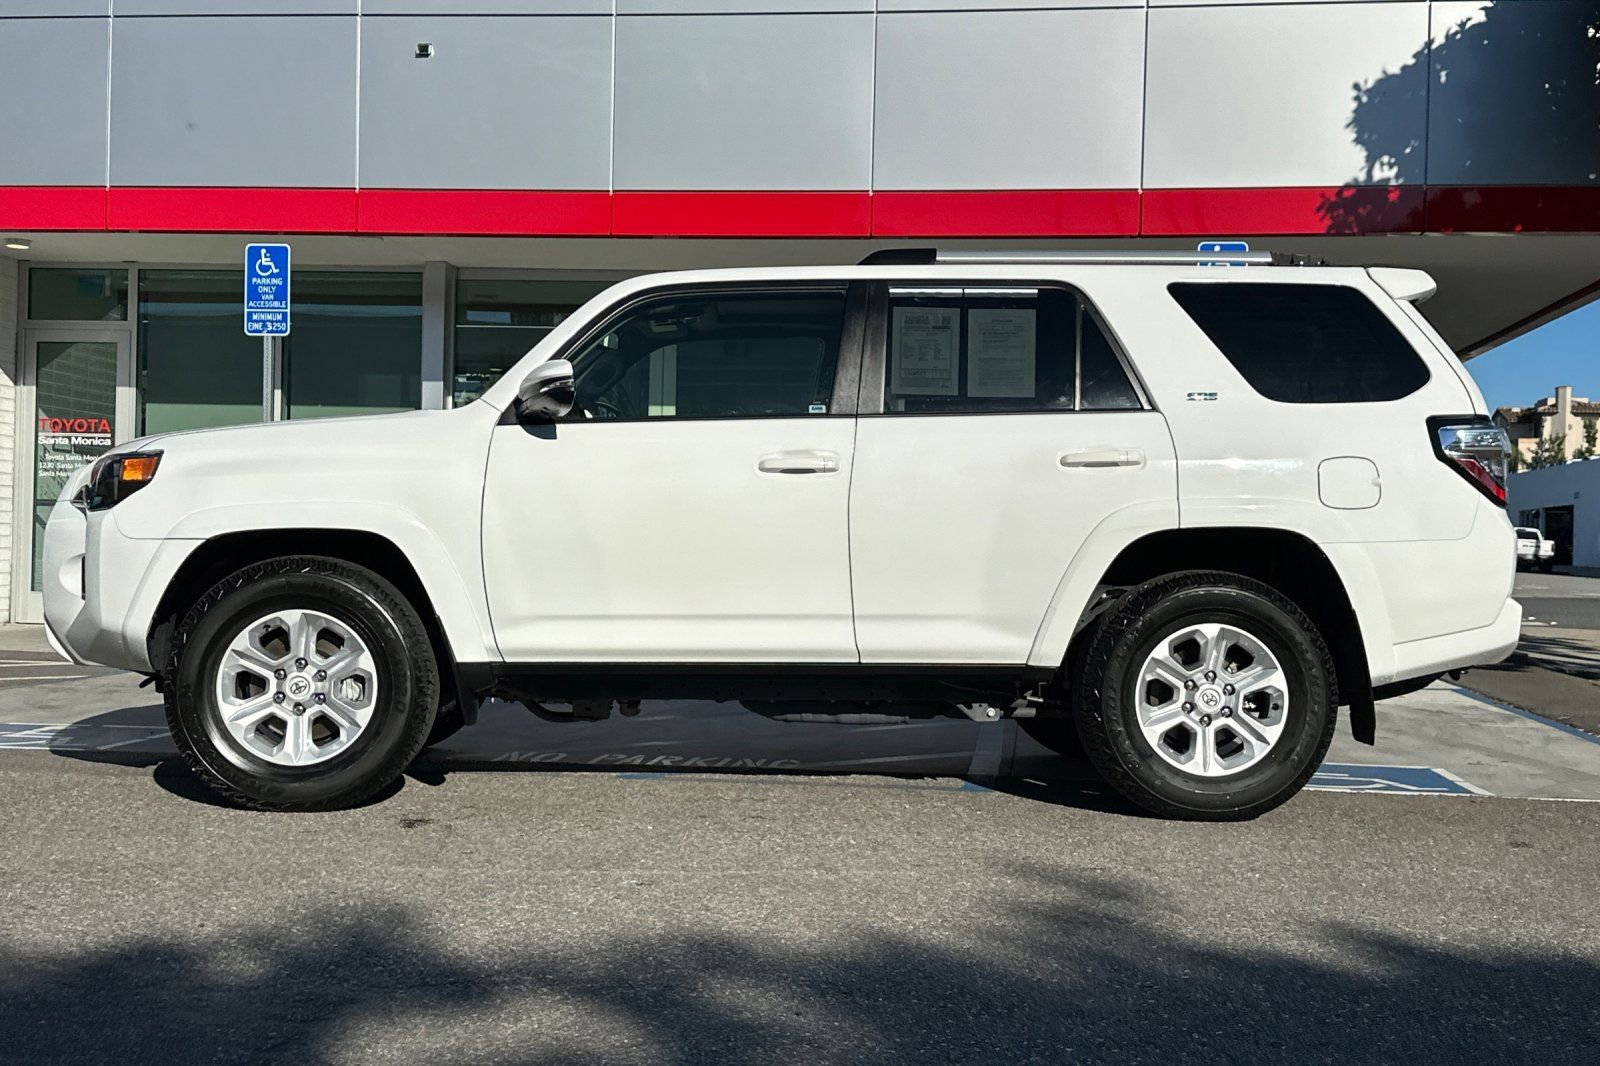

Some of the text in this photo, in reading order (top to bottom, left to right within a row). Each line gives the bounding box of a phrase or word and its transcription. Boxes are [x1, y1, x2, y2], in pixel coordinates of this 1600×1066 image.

[252, 277, 283, 285] PARKING
[258, 285, 276, 293] ONLY
[249, 300, 287, 308] ACCESSIBLE
[252, 312, 283, 321] MINIMUM
[39, 418, 111, 432] TOYOTA
[38, 436, 111, 446] Santa Monica
[45, 453, 64, 462] Toyota
[492, 751, 801, 769] NO PARKING
